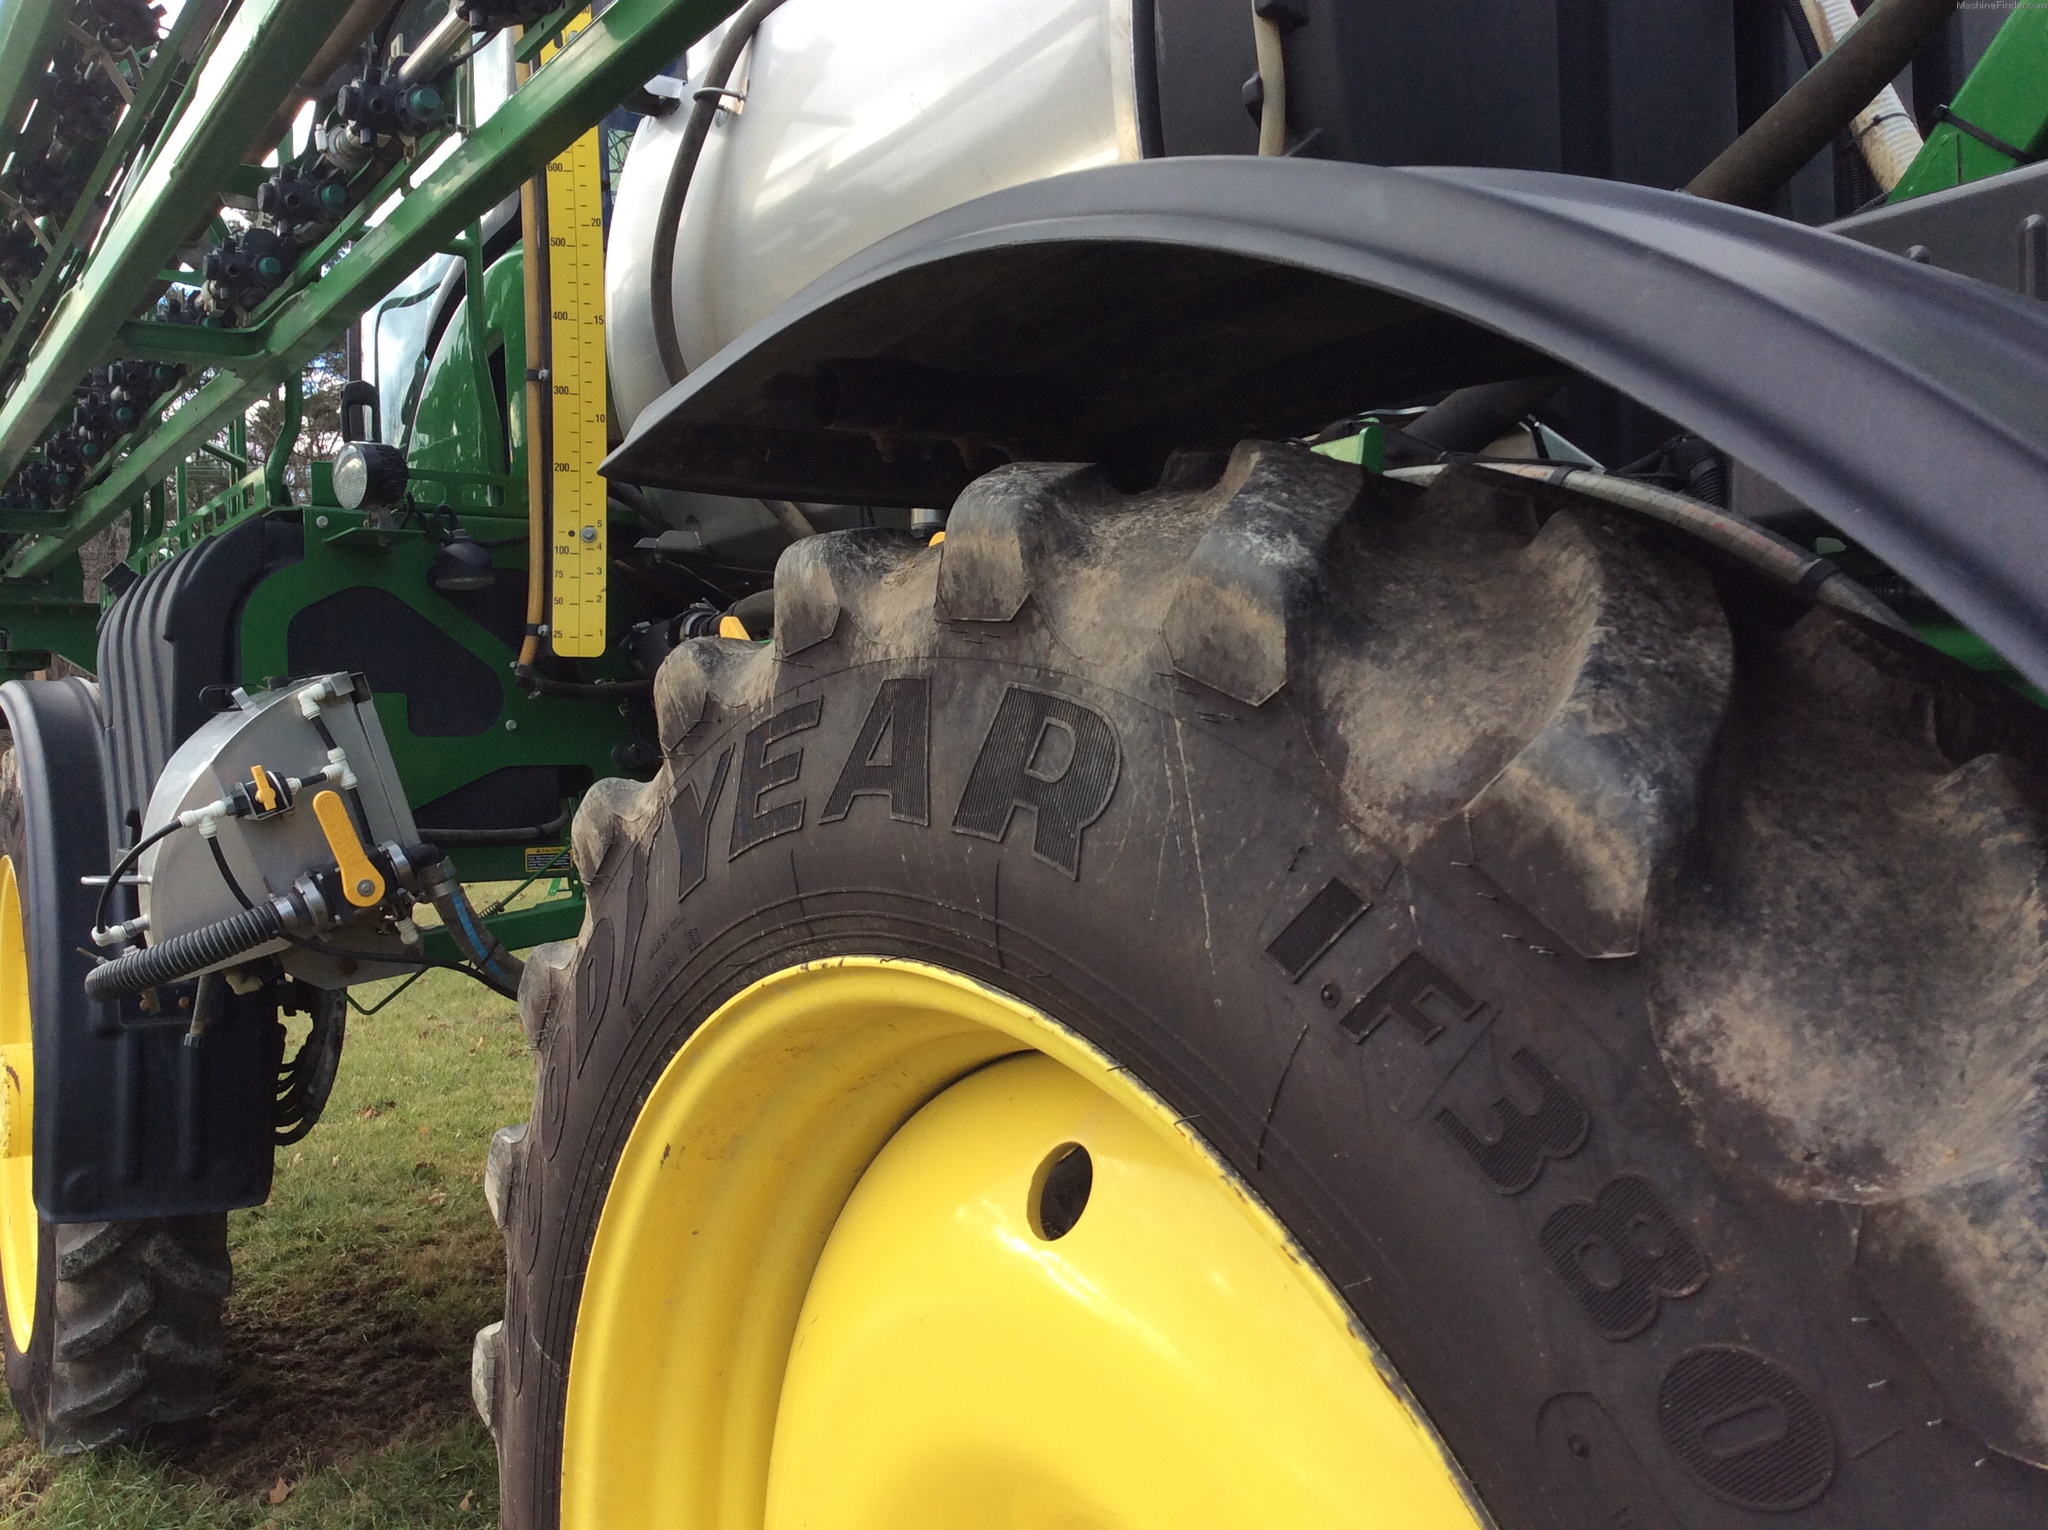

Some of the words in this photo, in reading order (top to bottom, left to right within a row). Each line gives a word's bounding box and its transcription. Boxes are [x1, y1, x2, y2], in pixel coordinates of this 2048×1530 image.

[547, 163, 563, 172] 600
[591, 218, 601, 227] 20
[550, 238, 566, 247] 500
[552, 311, 568, 321] 400
[594, 315, 604, 325] 15
[553, 386, 569, 395] 300
[595, 414, 606, 423] 10
[554, 463, 570, 472] 200
[597, 520, 603, 528] 5
[554, 545, 570, 554] 100
[596, 542, 603, 551] 4
[554, 570, 564, 579] 75
[596, 567, 603, 575] 3
[554, 597, 563, 606] 50
[596, 595, 602, 603] 2
[553, 630, 563, 638] 25
